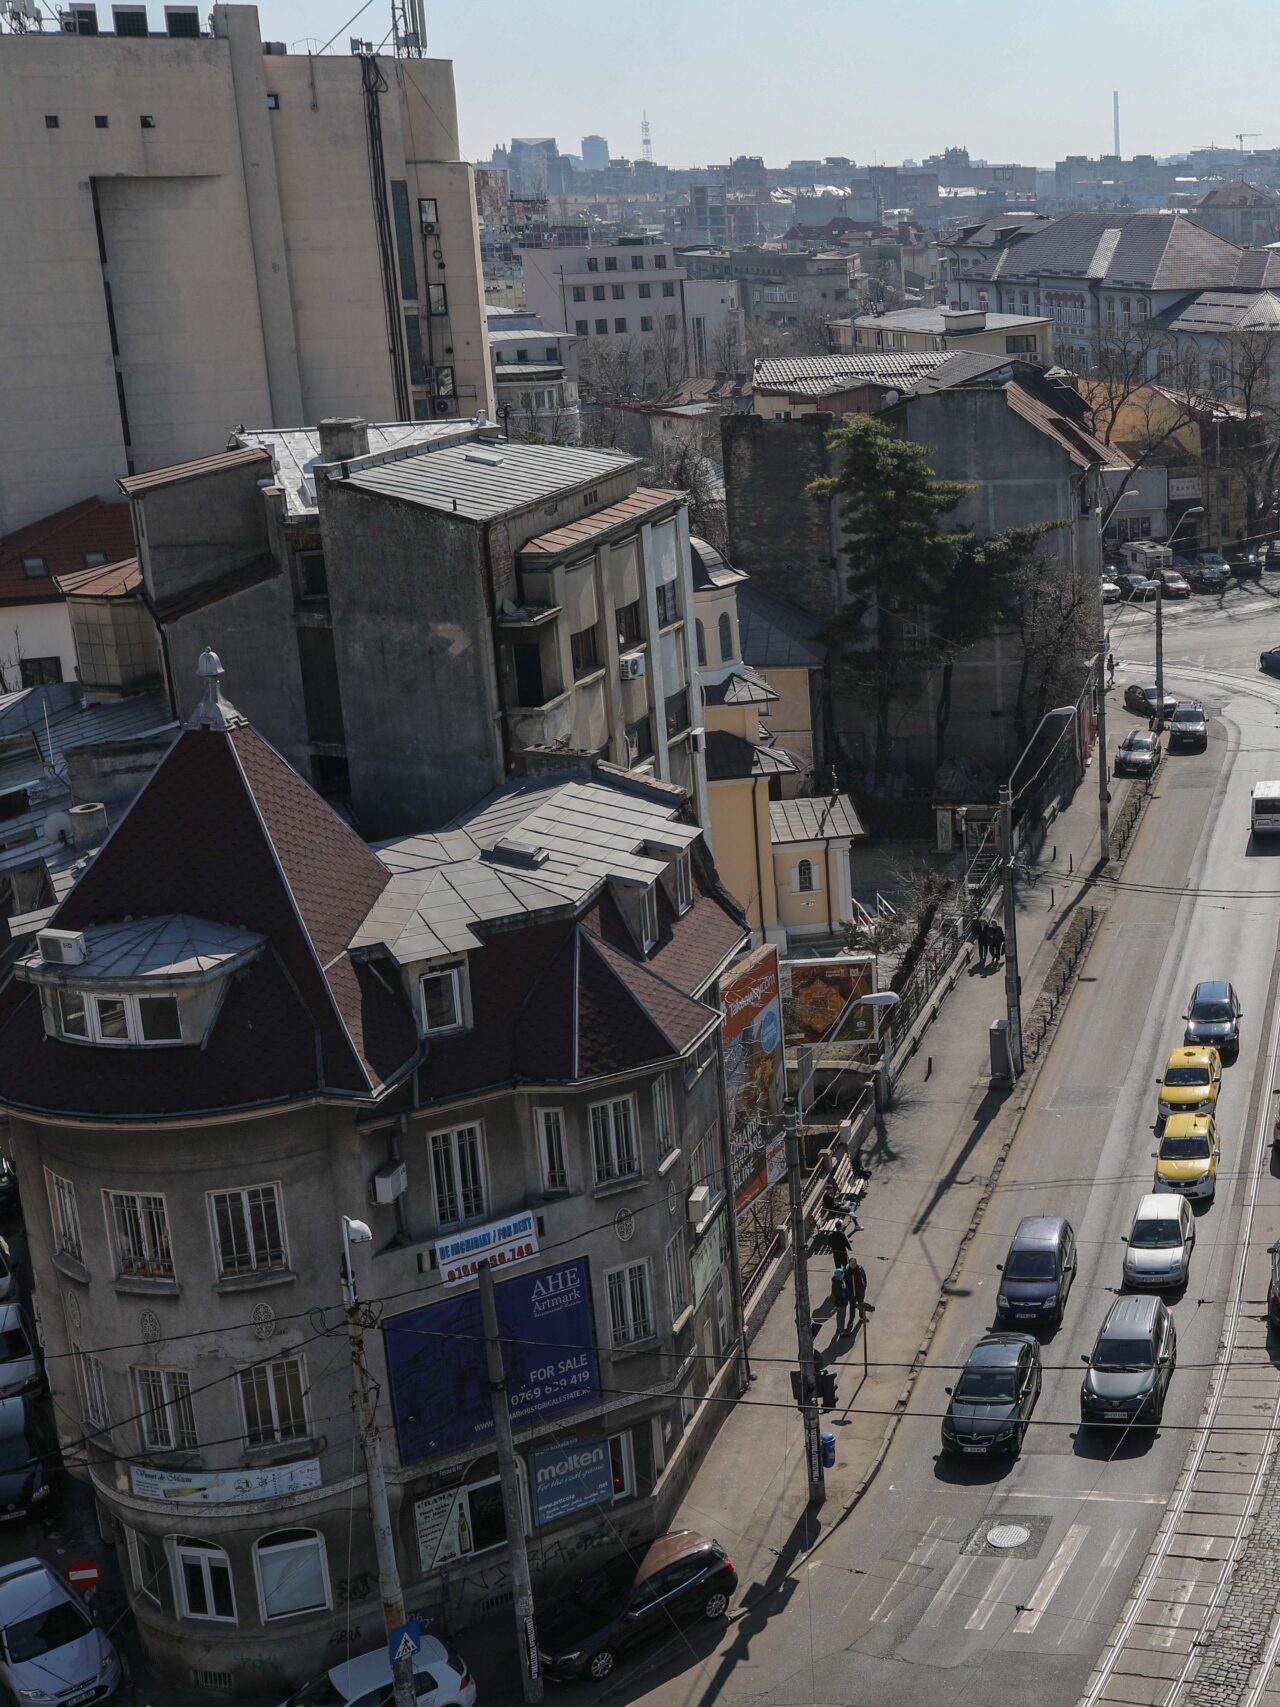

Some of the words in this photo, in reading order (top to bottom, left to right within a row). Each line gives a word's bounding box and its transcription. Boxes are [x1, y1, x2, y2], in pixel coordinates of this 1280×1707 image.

[438, 1243, 450, 1259] DE
[497, 1225, 512, 1240] FOR
[512, 1217, 532, 1235] RENT
[531, 1267, 580, 1298] AHE
[533, 1289, 581, 1312] Artmark
[530, 1366, 555, 1383] FOR
[557, 1354, 588, 1375] SALE
[511, 1388, 541, 1406] 0769
[570, 1370, 591, 1385] 419
[537, 1448, 604, 1483] molten
